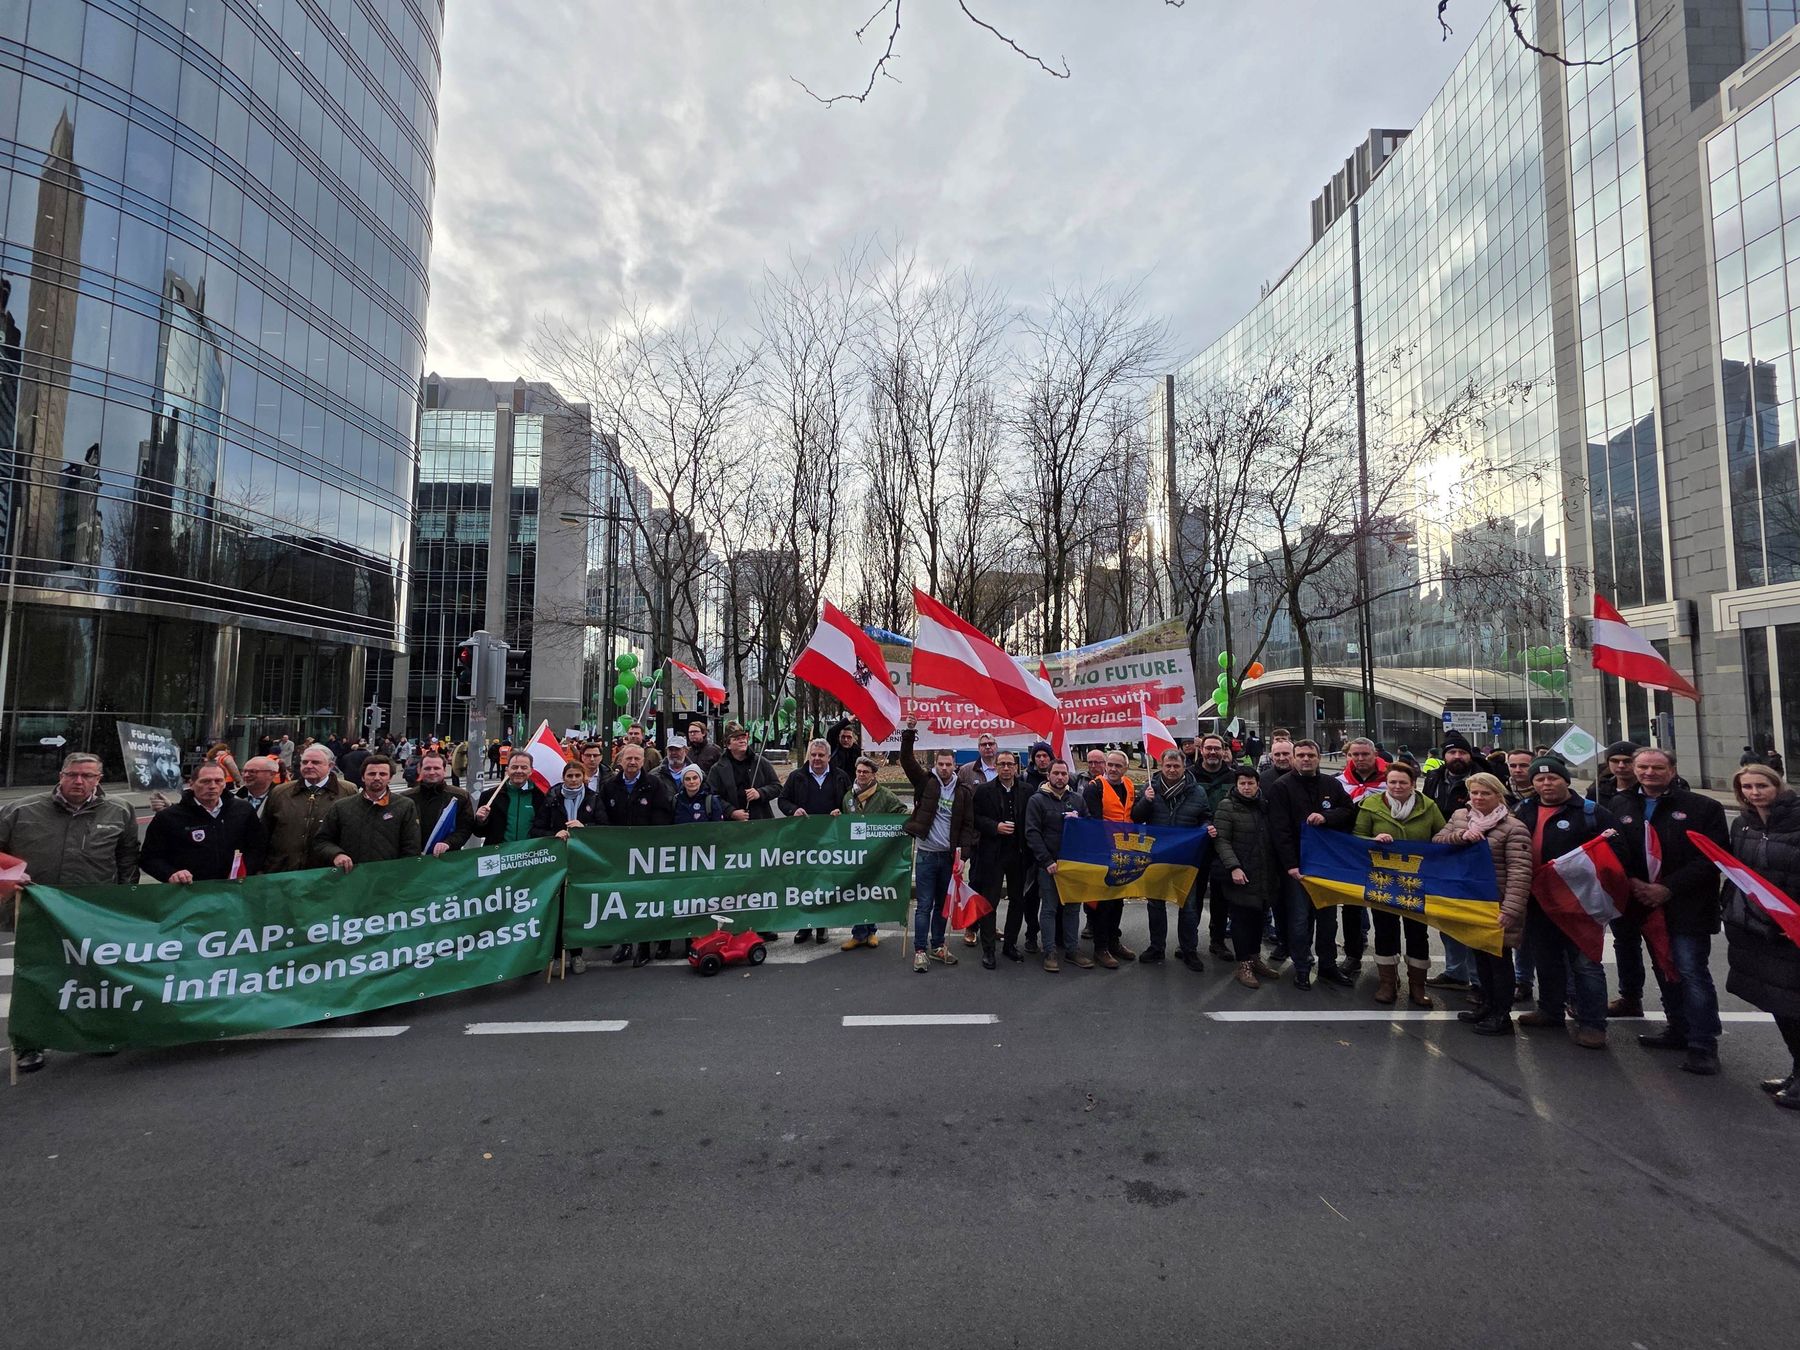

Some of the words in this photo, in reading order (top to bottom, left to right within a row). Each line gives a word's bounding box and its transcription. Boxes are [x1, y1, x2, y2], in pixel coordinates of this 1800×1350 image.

[1074, 669, 1100, 687] NO
[1105, 658, 1183, 682] FUTURE.
[1058, 693, 1108, 709] farms
[1111, 689, 1152, 705] with
[1062, 708, 1132, 725] Ukraine!
[1493, 716, 1501, 726] P
[130, 729, 146, 739] Für
[147, 733, 165, 743] eine
[500, 848, 549, 863] STEIRISCHER
[500, 855, 557, 871] BAUERNBUND
[628, 844, 716, 875] NEIN
[724, 853, 752, 869] zu
[760, 848, 867, 867] Mercosur
[583, 891, 628, 930] JA
[634, 900, 665, 919] zu
[672, 891, 778, 917] unseren
[785, 883, 897, 906] Betrieben
[62, 938, 183, 966] Neue
[197, 924, 295, 959] GAP:
[307, 885, 539, 945] eigenständig,
[58, 979, 144, 1012] fair,
[161, 917, 541, 1004] inflationsangepasst
